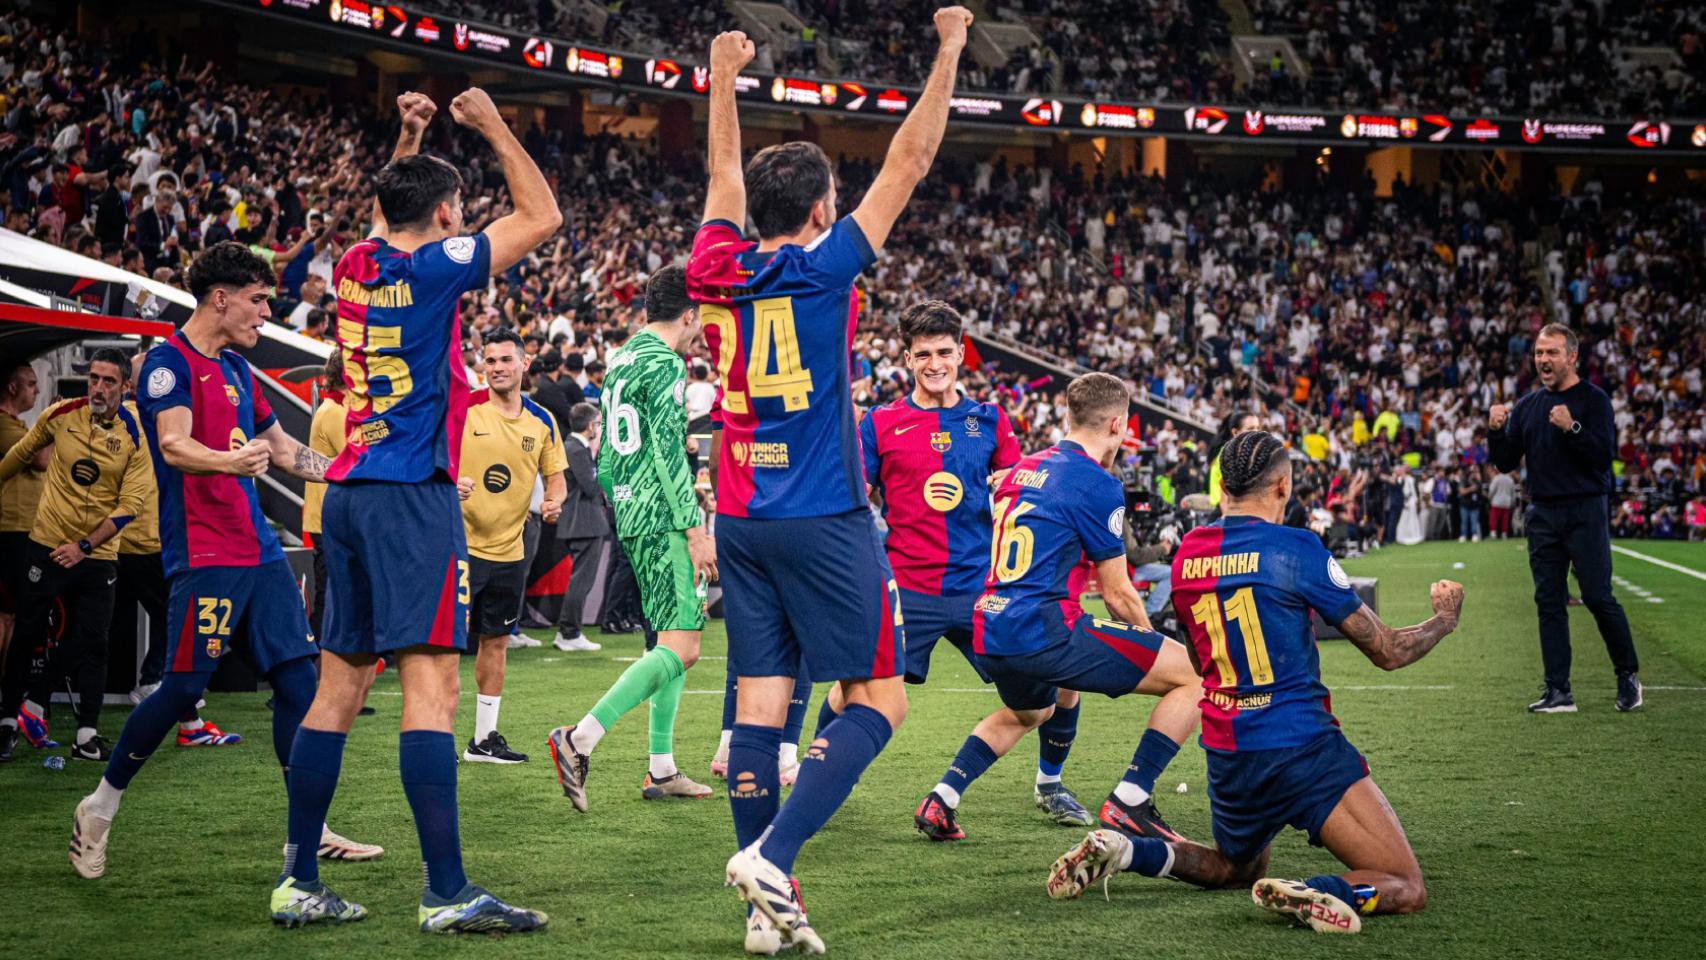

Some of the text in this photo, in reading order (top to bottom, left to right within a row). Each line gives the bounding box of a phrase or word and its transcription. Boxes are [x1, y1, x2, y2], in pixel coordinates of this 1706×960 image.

[1543, 123, 1605, 135] SUPERCOPA
[338, 317, 413, 414] 35
[699, 296, 814, 414] 24
[749, 442, 788, 453] UNHCR
[749, 453, 789, 464] ACNUR
[991, 496, 1037, 583] 16
[1181, 552, 1260, 580] RAPHINHA
[198, 597, 232, 635] 32
[1190, 587, 1274, 687] 11
[1236, 695, 1273, 707] ACNUR
